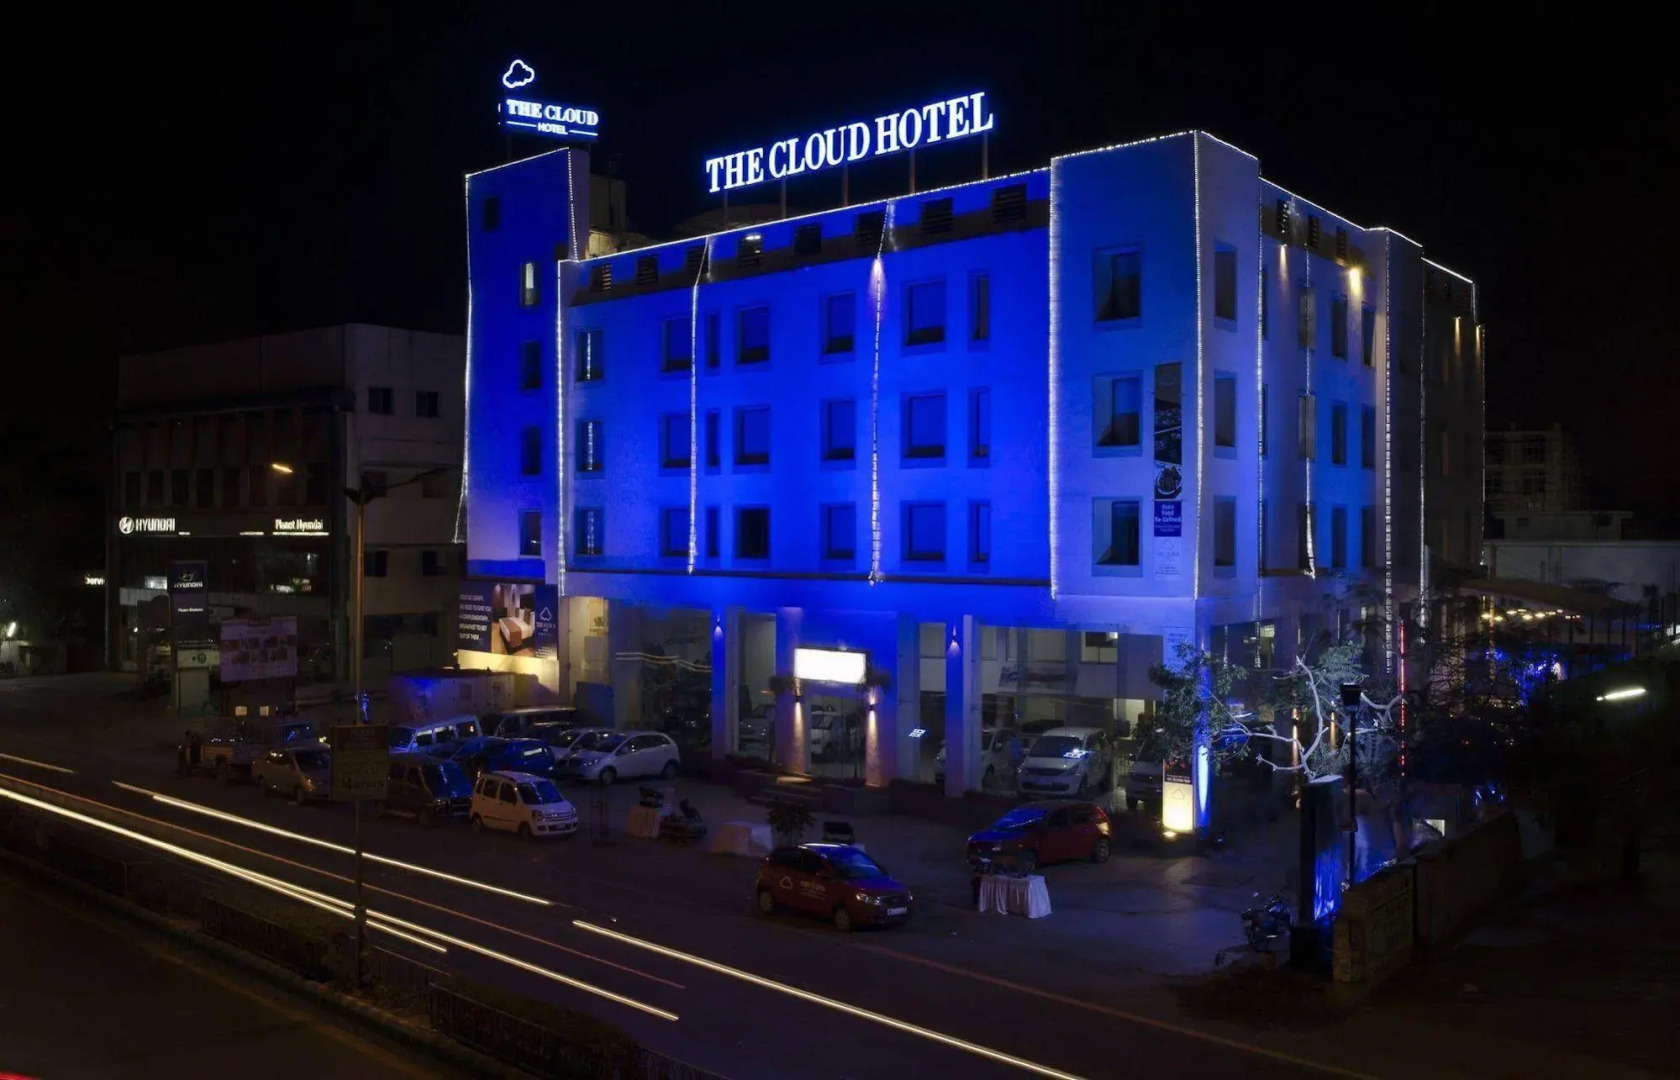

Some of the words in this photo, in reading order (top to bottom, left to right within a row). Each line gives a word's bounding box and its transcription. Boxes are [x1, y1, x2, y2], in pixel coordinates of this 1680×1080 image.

[506, 98, 542, 119] THE
[544, 104, 599, 126] CLOUD
[537, 122, 568, 135] HOTEL
[705, 147, 764, 193] THE
[768, 122, 871, 179] CLOUD
[874, 91, 994, 155] HOTEL
[135, 517, 176, 532] HYUNDAI
[296, 518, 324, 532] Hyundai
[173, 581, 203, 589] HYUNDAI
